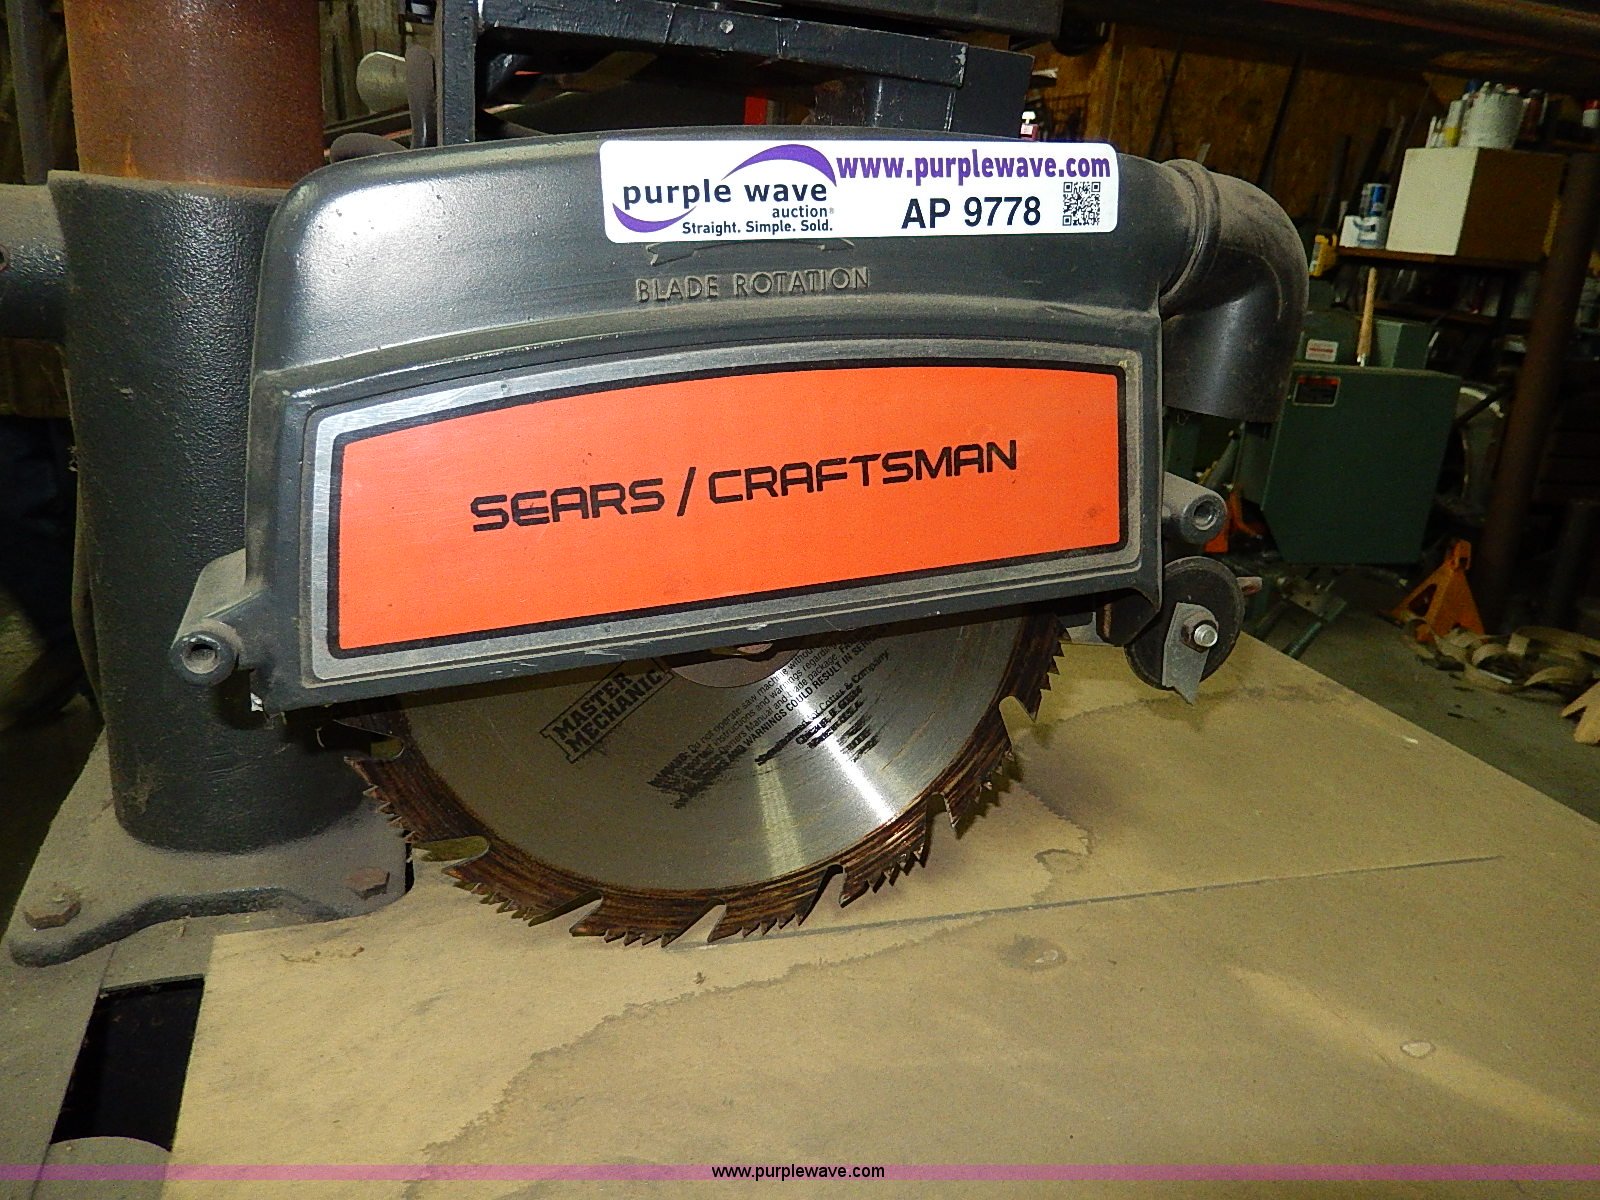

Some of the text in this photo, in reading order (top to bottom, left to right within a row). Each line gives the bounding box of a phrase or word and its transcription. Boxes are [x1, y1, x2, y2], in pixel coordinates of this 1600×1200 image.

[836, 148, 1111, 186] www.purplewave.com
[623, 178, 827, 210] purple wave
[901, 196, 1041, 229] AP 9778
[682, 220, 833, 236] Straight. Simple. Sold.
[635, 266, 870, 303] BLADE ROTATION
[740, 693, 757, 709] saw
[786, 643, 816, 670] withou
[553, 670, 634, 740] MASTER
[565, 669, 665, 754] MECHANIC
[742, 707, 787, 747] WARNINGS
[784, 685, 813, 711] COULD
[811, 660, 844, 689] RESULT
[840, 651, 853, 664] IN
[744, 705, 774, 732] Manual
[771, 694, 788, 709] and
[712, 708, 756, 746] instructions
[754, 695, 770, 710] and
